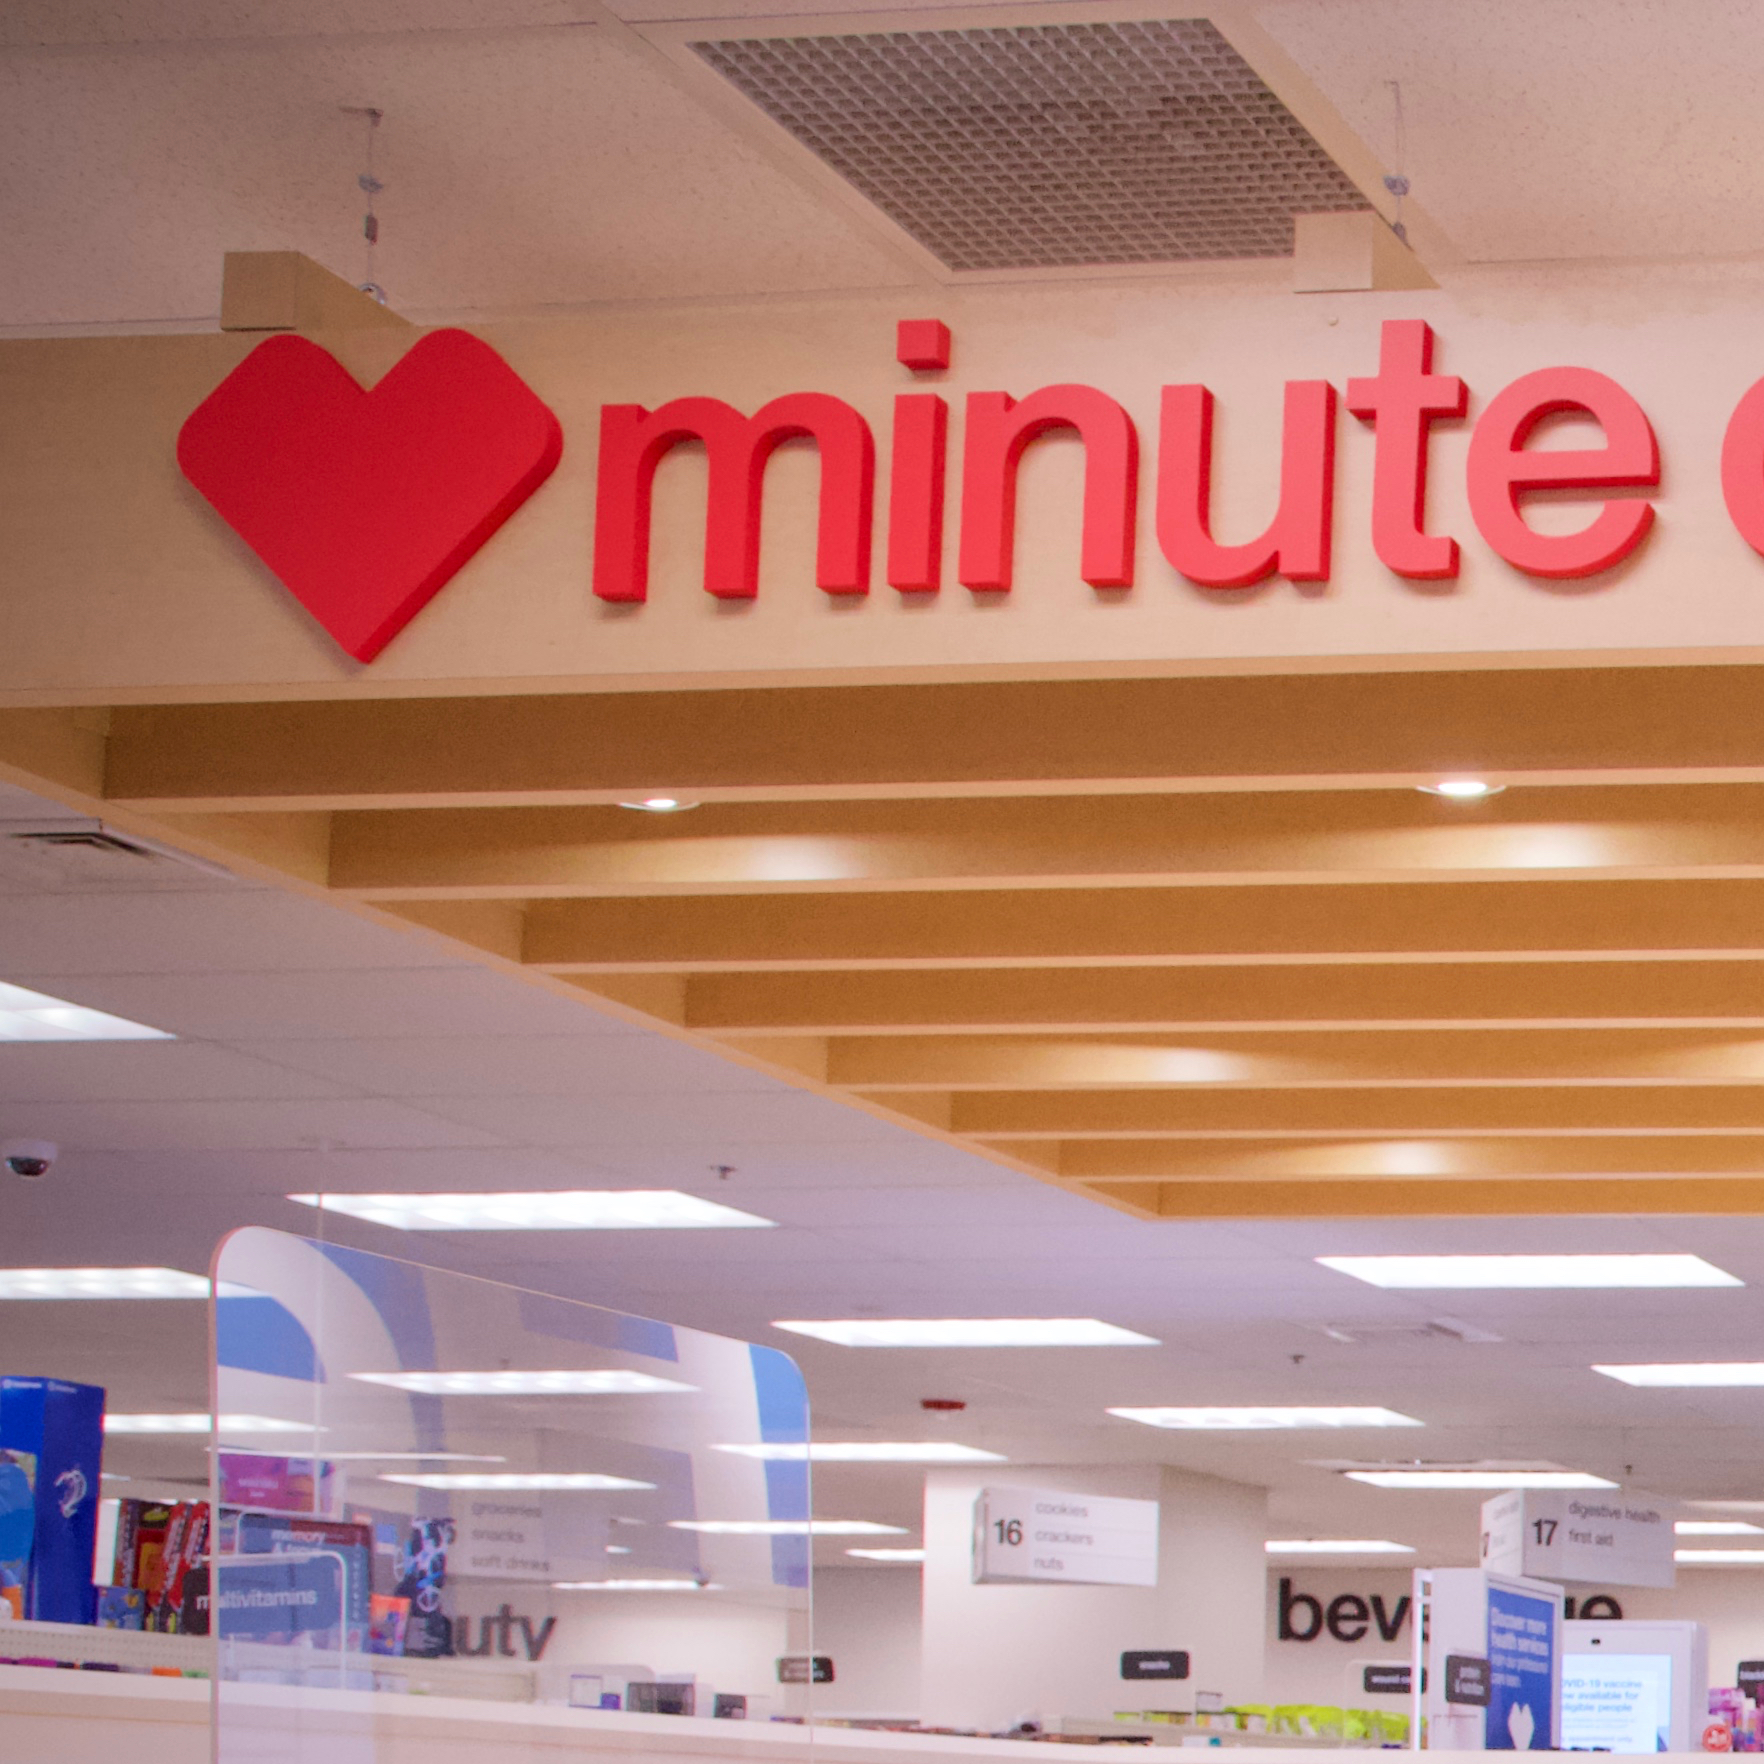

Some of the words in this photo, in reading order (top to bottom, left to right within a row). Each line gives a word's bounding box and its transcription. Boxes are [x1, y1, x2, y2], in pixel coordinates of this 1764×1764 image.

[593, 318, 1660, 600] minute
[994, 1519, 1023, 1546] 16
[1532, 1518, 1558, 1547] 17
